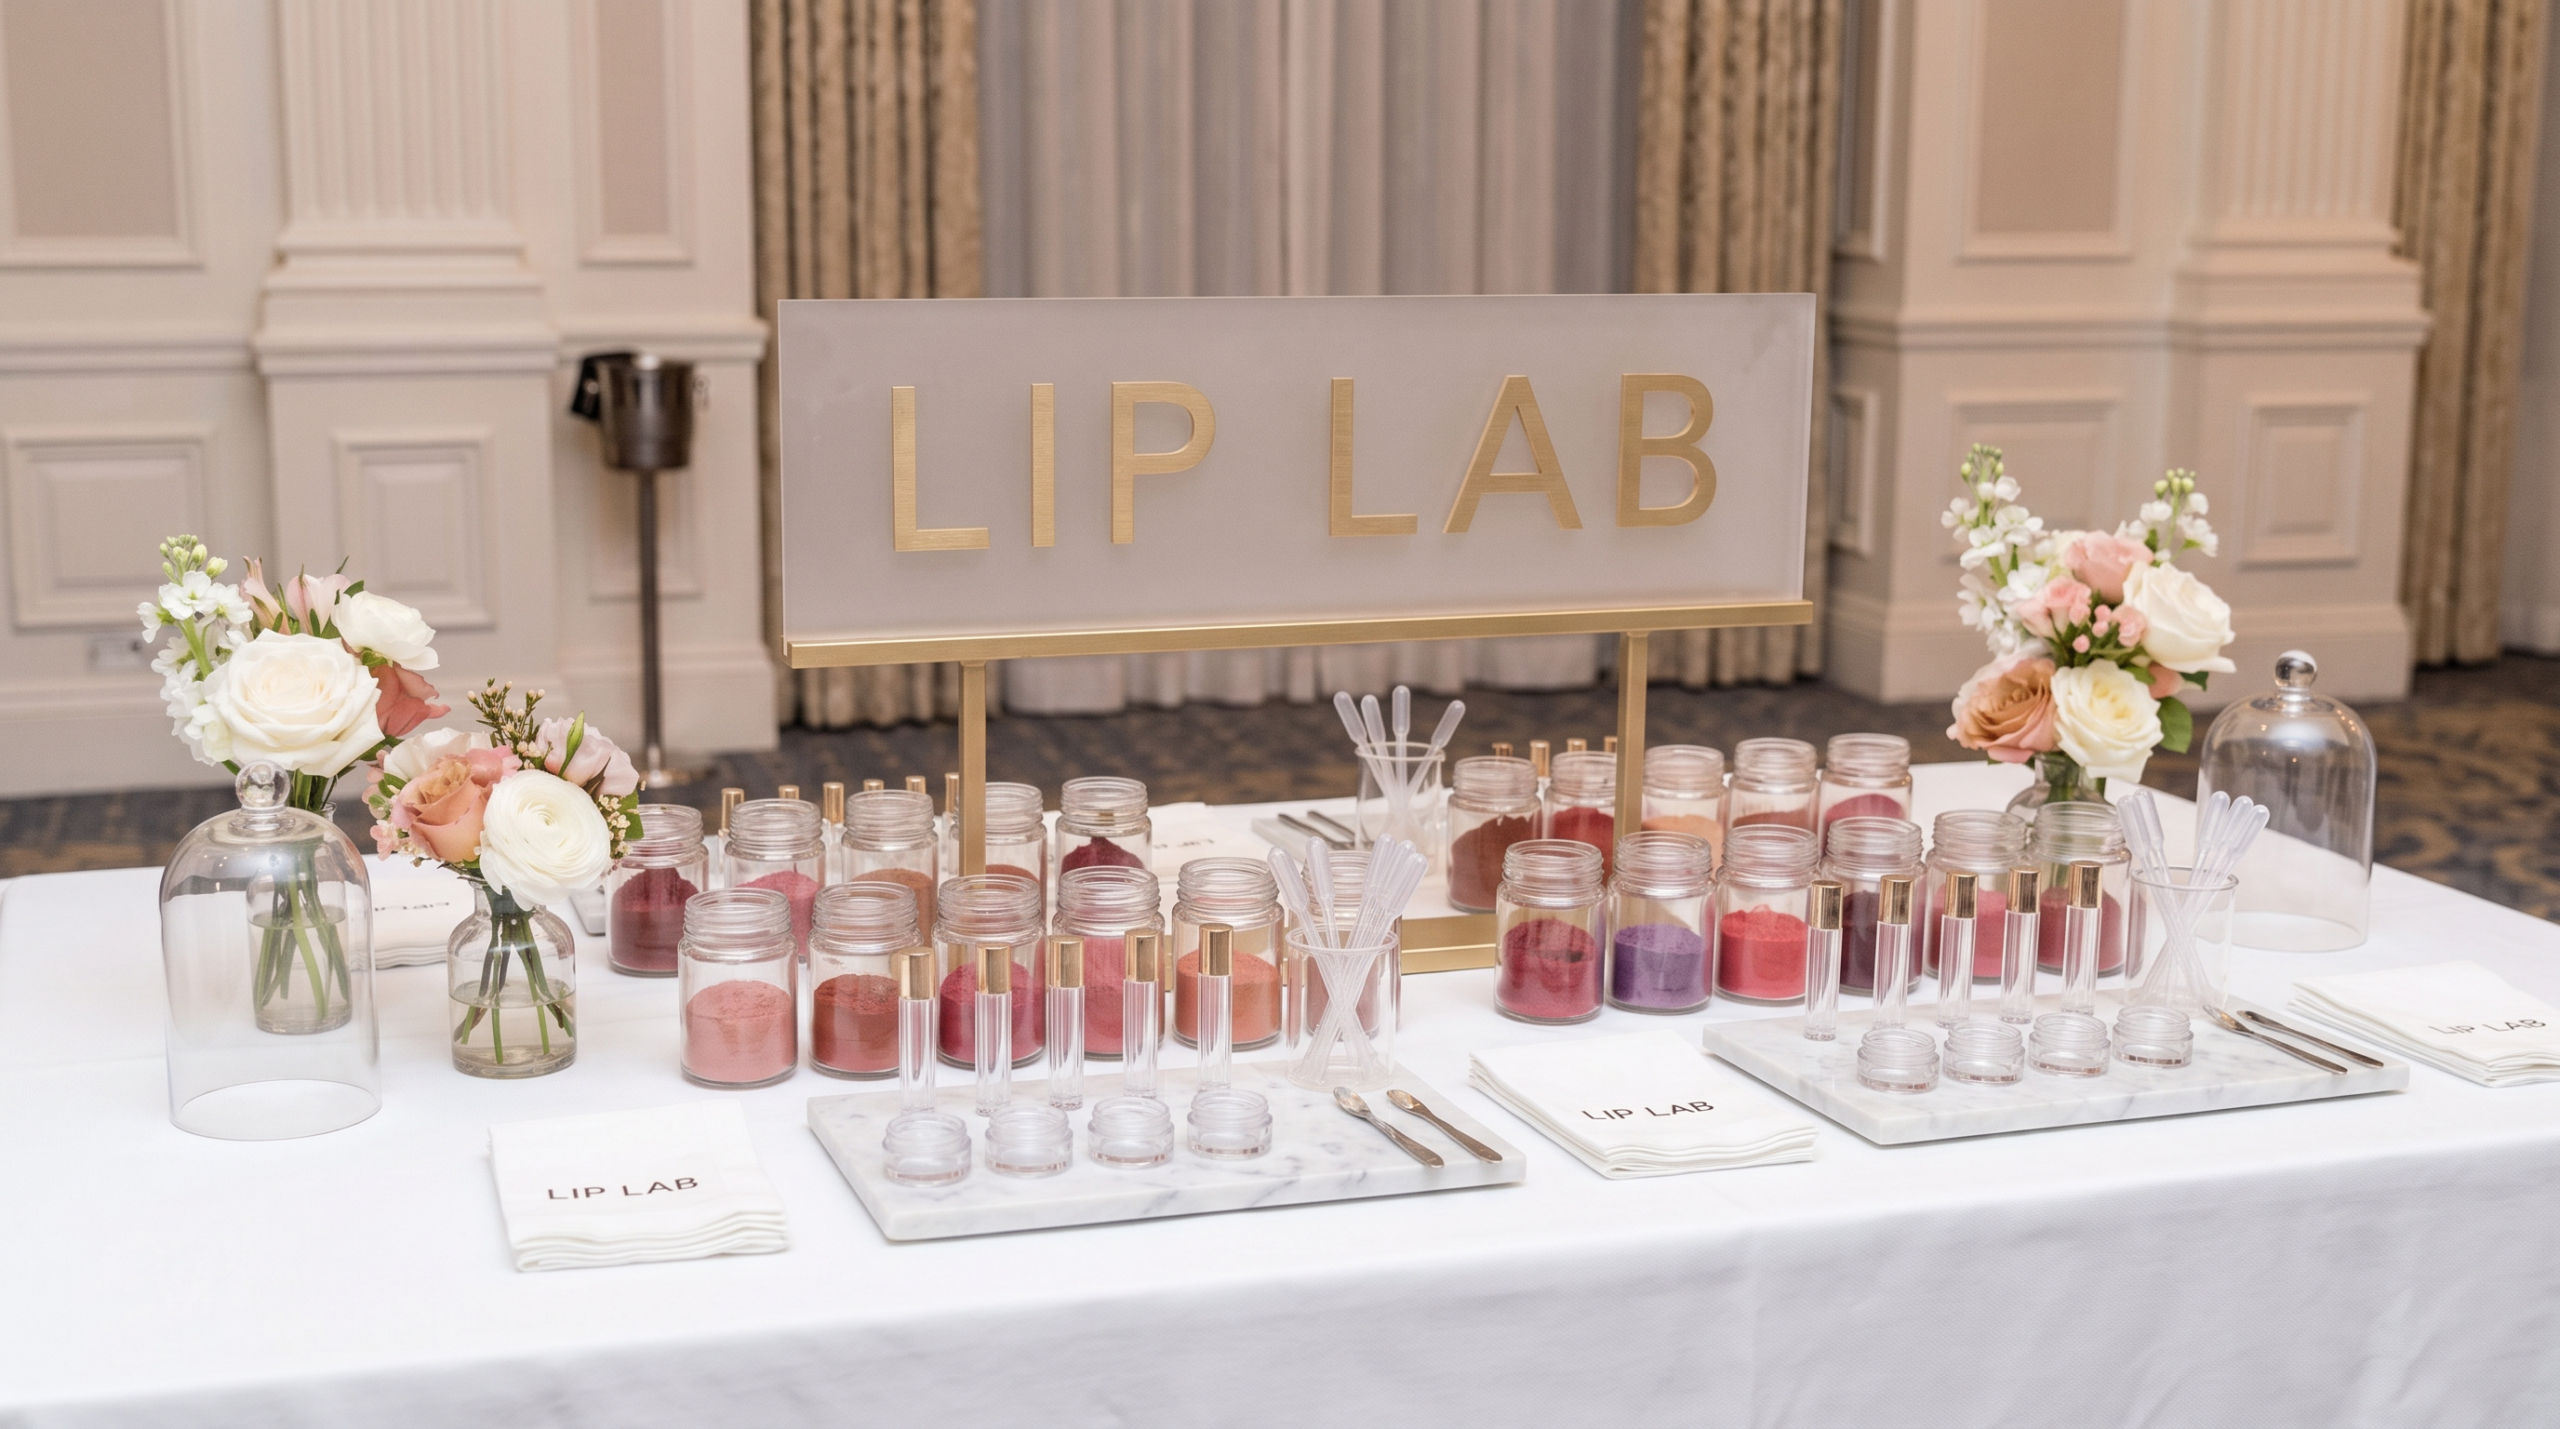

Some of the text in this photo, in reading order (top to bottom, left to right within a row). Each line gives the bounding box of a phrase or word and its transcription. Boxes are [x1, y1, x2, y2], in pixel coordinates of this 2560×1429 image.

[891, 373, 1718, 552] LIP LAB
[2427, 1019, 2547, 1035] LIP LAB
[1581, 1100, 1715, 1120] LIP LAB
[547, 1177, 699, 1200] LIP LAB
